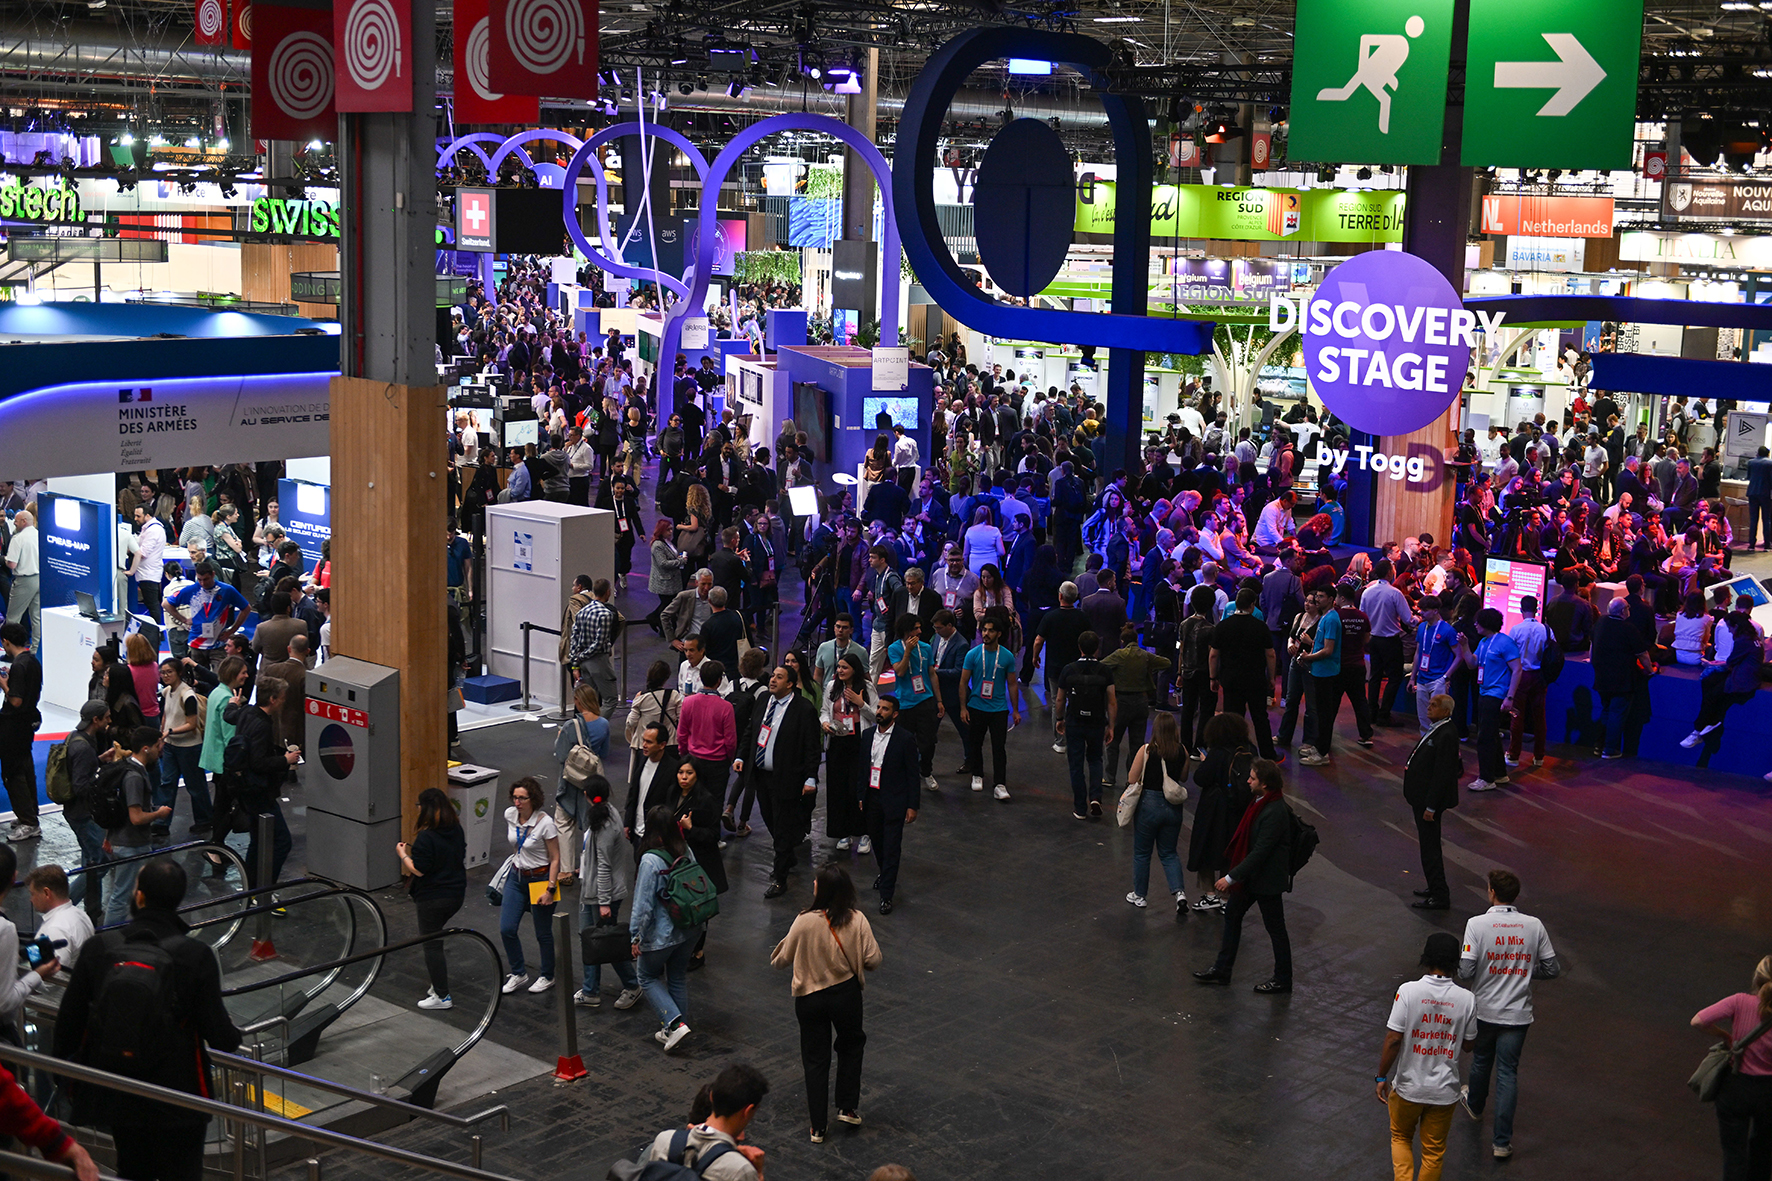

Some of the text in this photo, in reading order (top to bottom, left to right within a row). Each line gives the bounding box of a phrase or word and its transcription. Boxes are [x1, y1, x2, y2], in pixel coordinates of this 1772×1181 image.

[540, 175, 552, 185] AI
[1733, 186, 1772, 198] NOUV
[1238, 203, 1264, 213] SUD
[1742, 199, 1772, 212] AQU
[1338, 214, 1381, 230] TERRE
[1483, 199, 1503, 231] NL
[1522, 219, 1609, 234] Netherlands
[1657, 238, 1737, 259] ITALIA
[1512, 251, 1551, 262] BAVARIA
[1238, 272, 1273, 287] Belgium
[1268, 296, 1507, 348] DISCOVERY
[1316, 346, 1449, 393] STAGE
[119, 403, 187, 420] MINISTÈRE
[119, 417, 197, 434] DES ARMÉES
[240, 417, 257, 426] AU
[261, 415, 311, 425] SERVICE
[1317, 441, 1424, 482] by Togg
[1495, 935, 1525, 946] AI Mix
[1487, 951, 1532, 963] Marketing
[1489, 966, 1528, 978] Modeling
[1421, 1013, 1452, 1025] AI Mix
[1411, 1029, 1457, 1045] Marketing
[1413, 1044, 1454, 1060] Modeling
